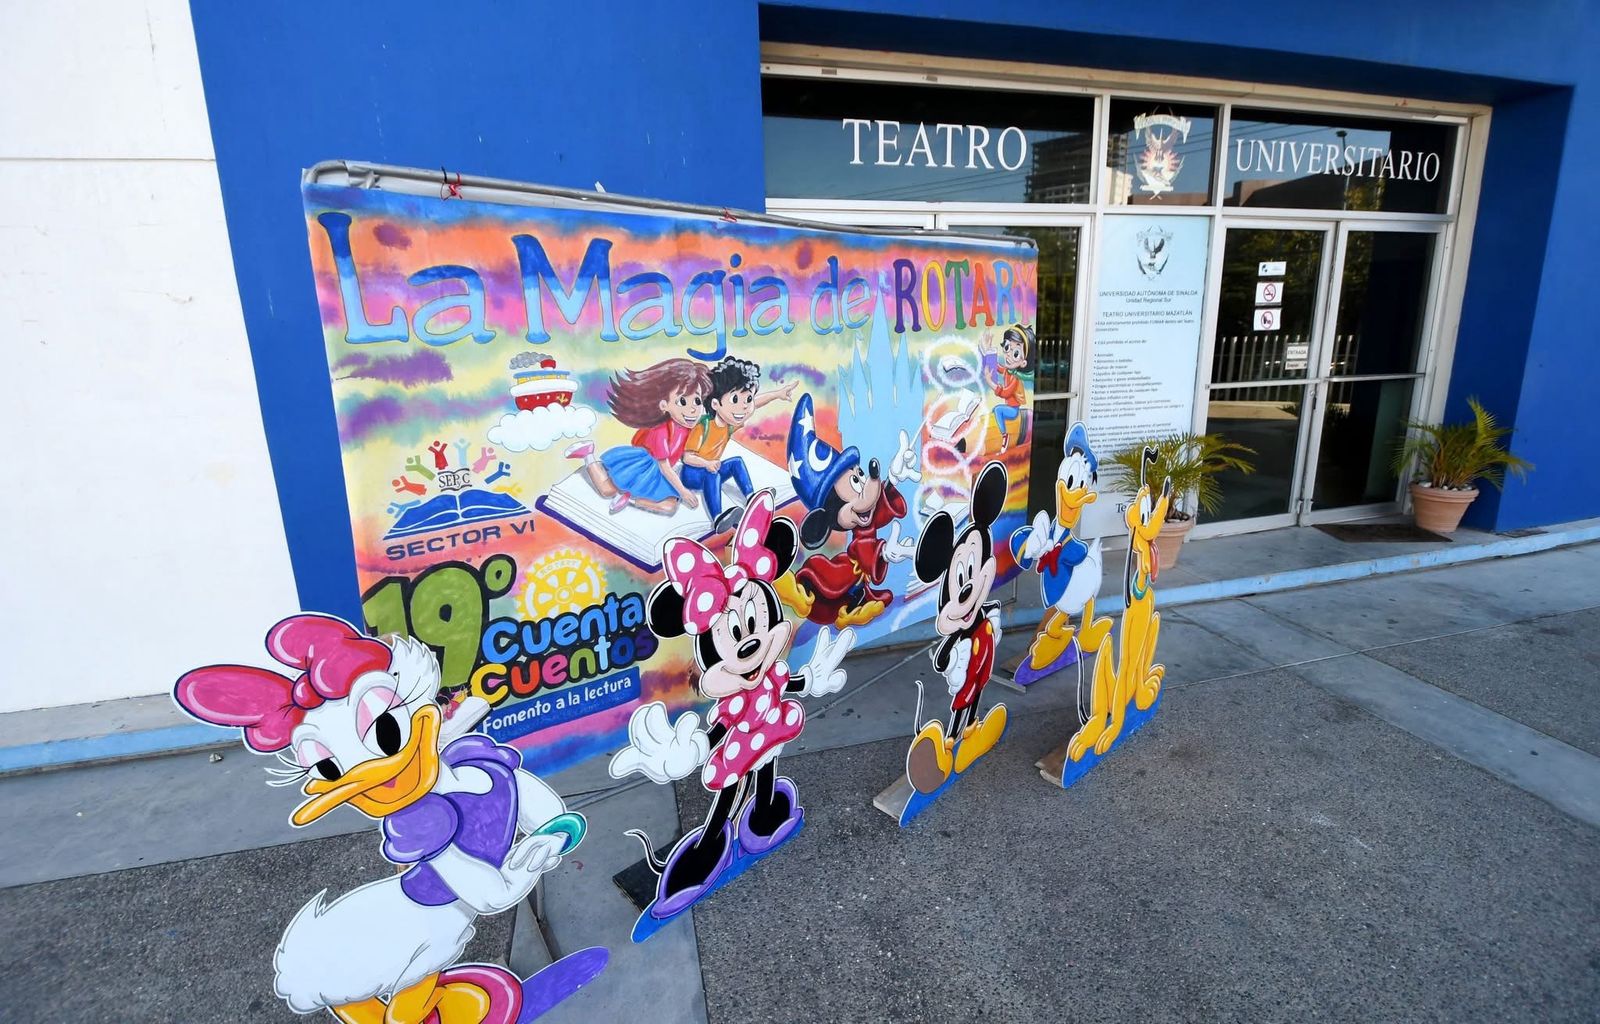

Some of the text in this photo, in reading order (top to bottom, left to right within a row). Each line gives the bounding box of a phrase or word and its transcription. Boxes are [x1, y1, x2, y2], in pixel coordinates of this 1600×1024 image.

[842, 118, 1027, 171] TEATRO
[1235, 138, 1441, 183] UNIVERSITARIO
[317, 211, 1036, 362] La Magia de ROTARY
[385, 519, 535, 561] SECTOR VI
[481, 593, 646, 665] Cuenta
[482, 701, 552, 734] Fomento
[555, 697, 565, 710] a
[567, 691, 581, 706] la
[584, 676, 632, 702] lectura
